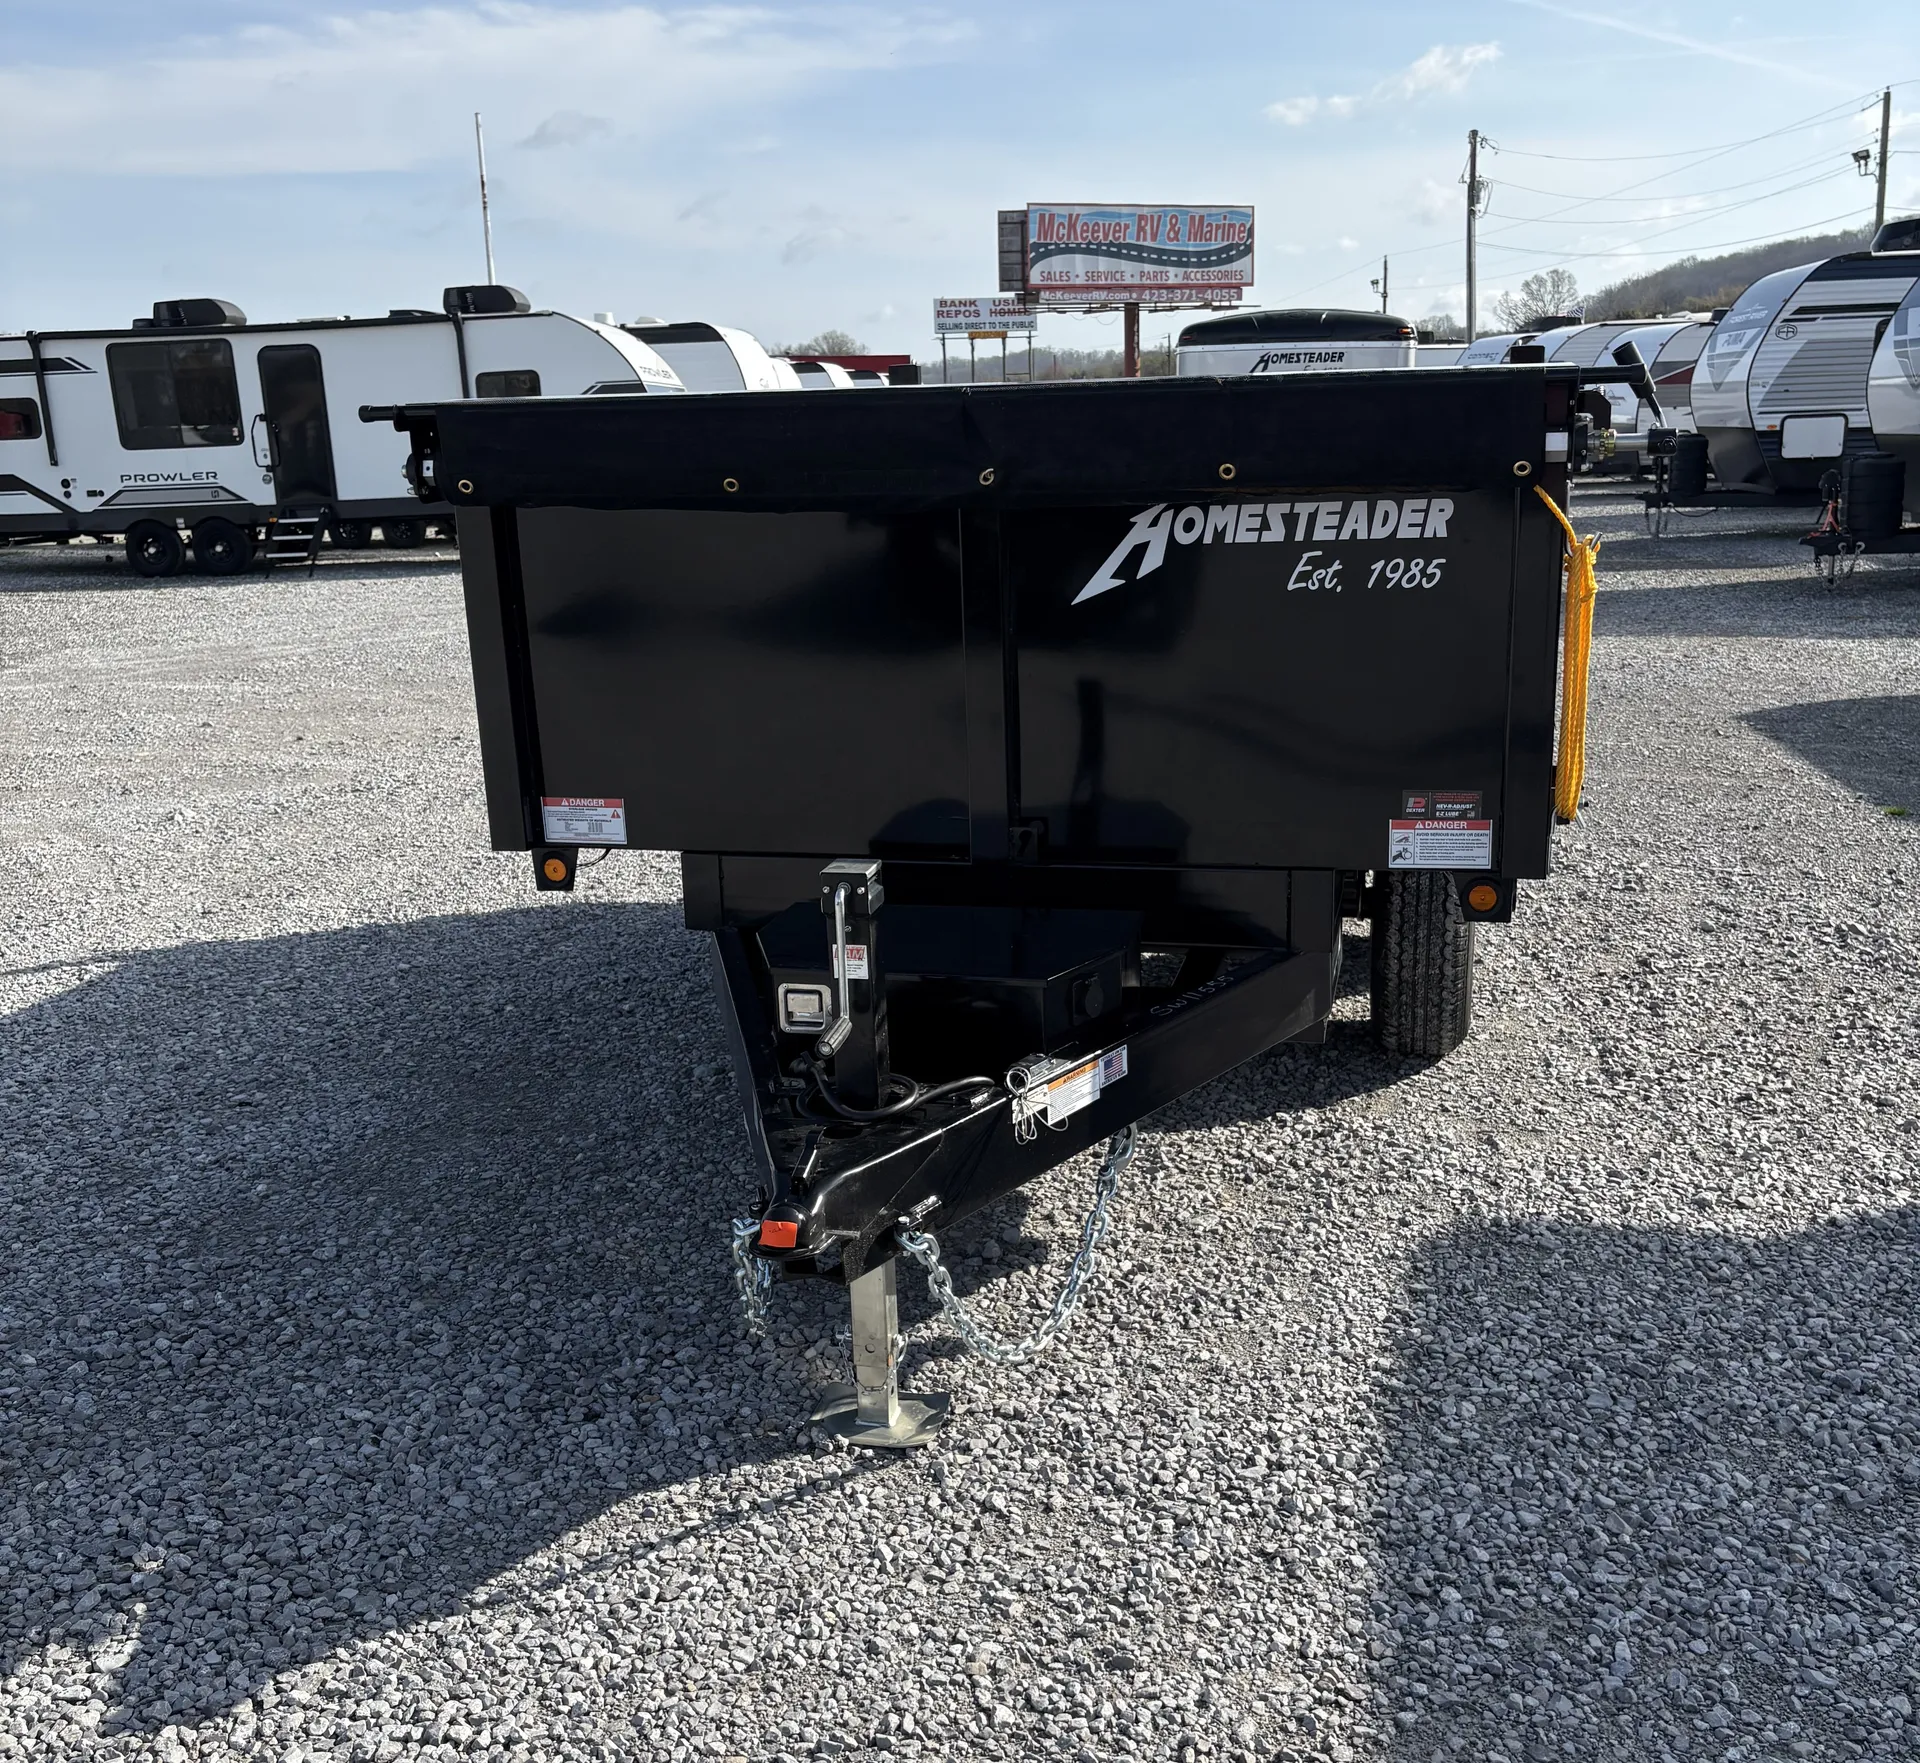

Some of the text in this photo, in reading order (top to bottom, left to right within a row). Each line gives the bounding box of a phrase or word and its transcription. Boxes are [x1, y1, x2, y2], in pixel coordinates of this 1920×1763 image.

[1036, 212, 1247, 243] McKeever RV & Marine
[1039, 269, 1244, 282] SALES SERVICE PARTS ACCESSORIES
[1141, 289, 1238, 301] 423-371-4055
[939, 299, 978, 308] BANK
[936, 309, 981, 318] REPOS
[937, 320, 1034, 330] SELLING DIRECT TO THE PUBLIC
[1249, 351, 1345, 373] HOMESTEADER
[120, 471, 218, 483] PROWLER
[1071, 498, 1454, 606] HOMESTEADER
[1287, 550, 1446, 593] Est. 1985
[569, 798, 605, 806] DANGER
[1425, 821, 1467, 829] DANGER
